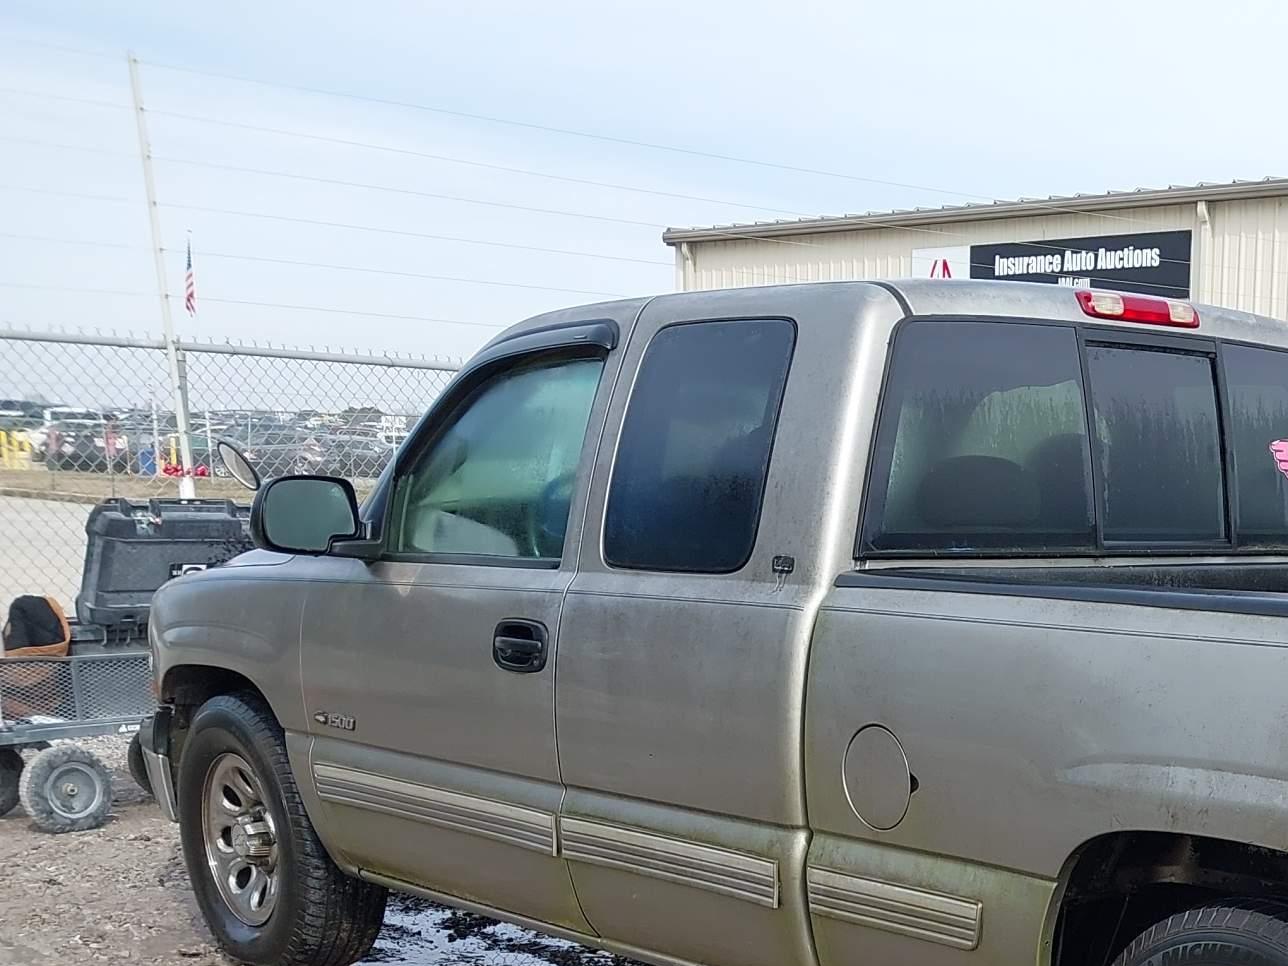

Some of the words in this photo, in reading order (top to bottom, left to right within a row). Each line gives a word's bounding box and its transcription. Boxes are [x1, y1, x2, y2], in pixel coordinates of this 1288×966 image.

[994, 254, 1062, 276] Insurance
[1063, 250, 1095, 272] Auto
[1096, 246, 1161, 270] Auctions
